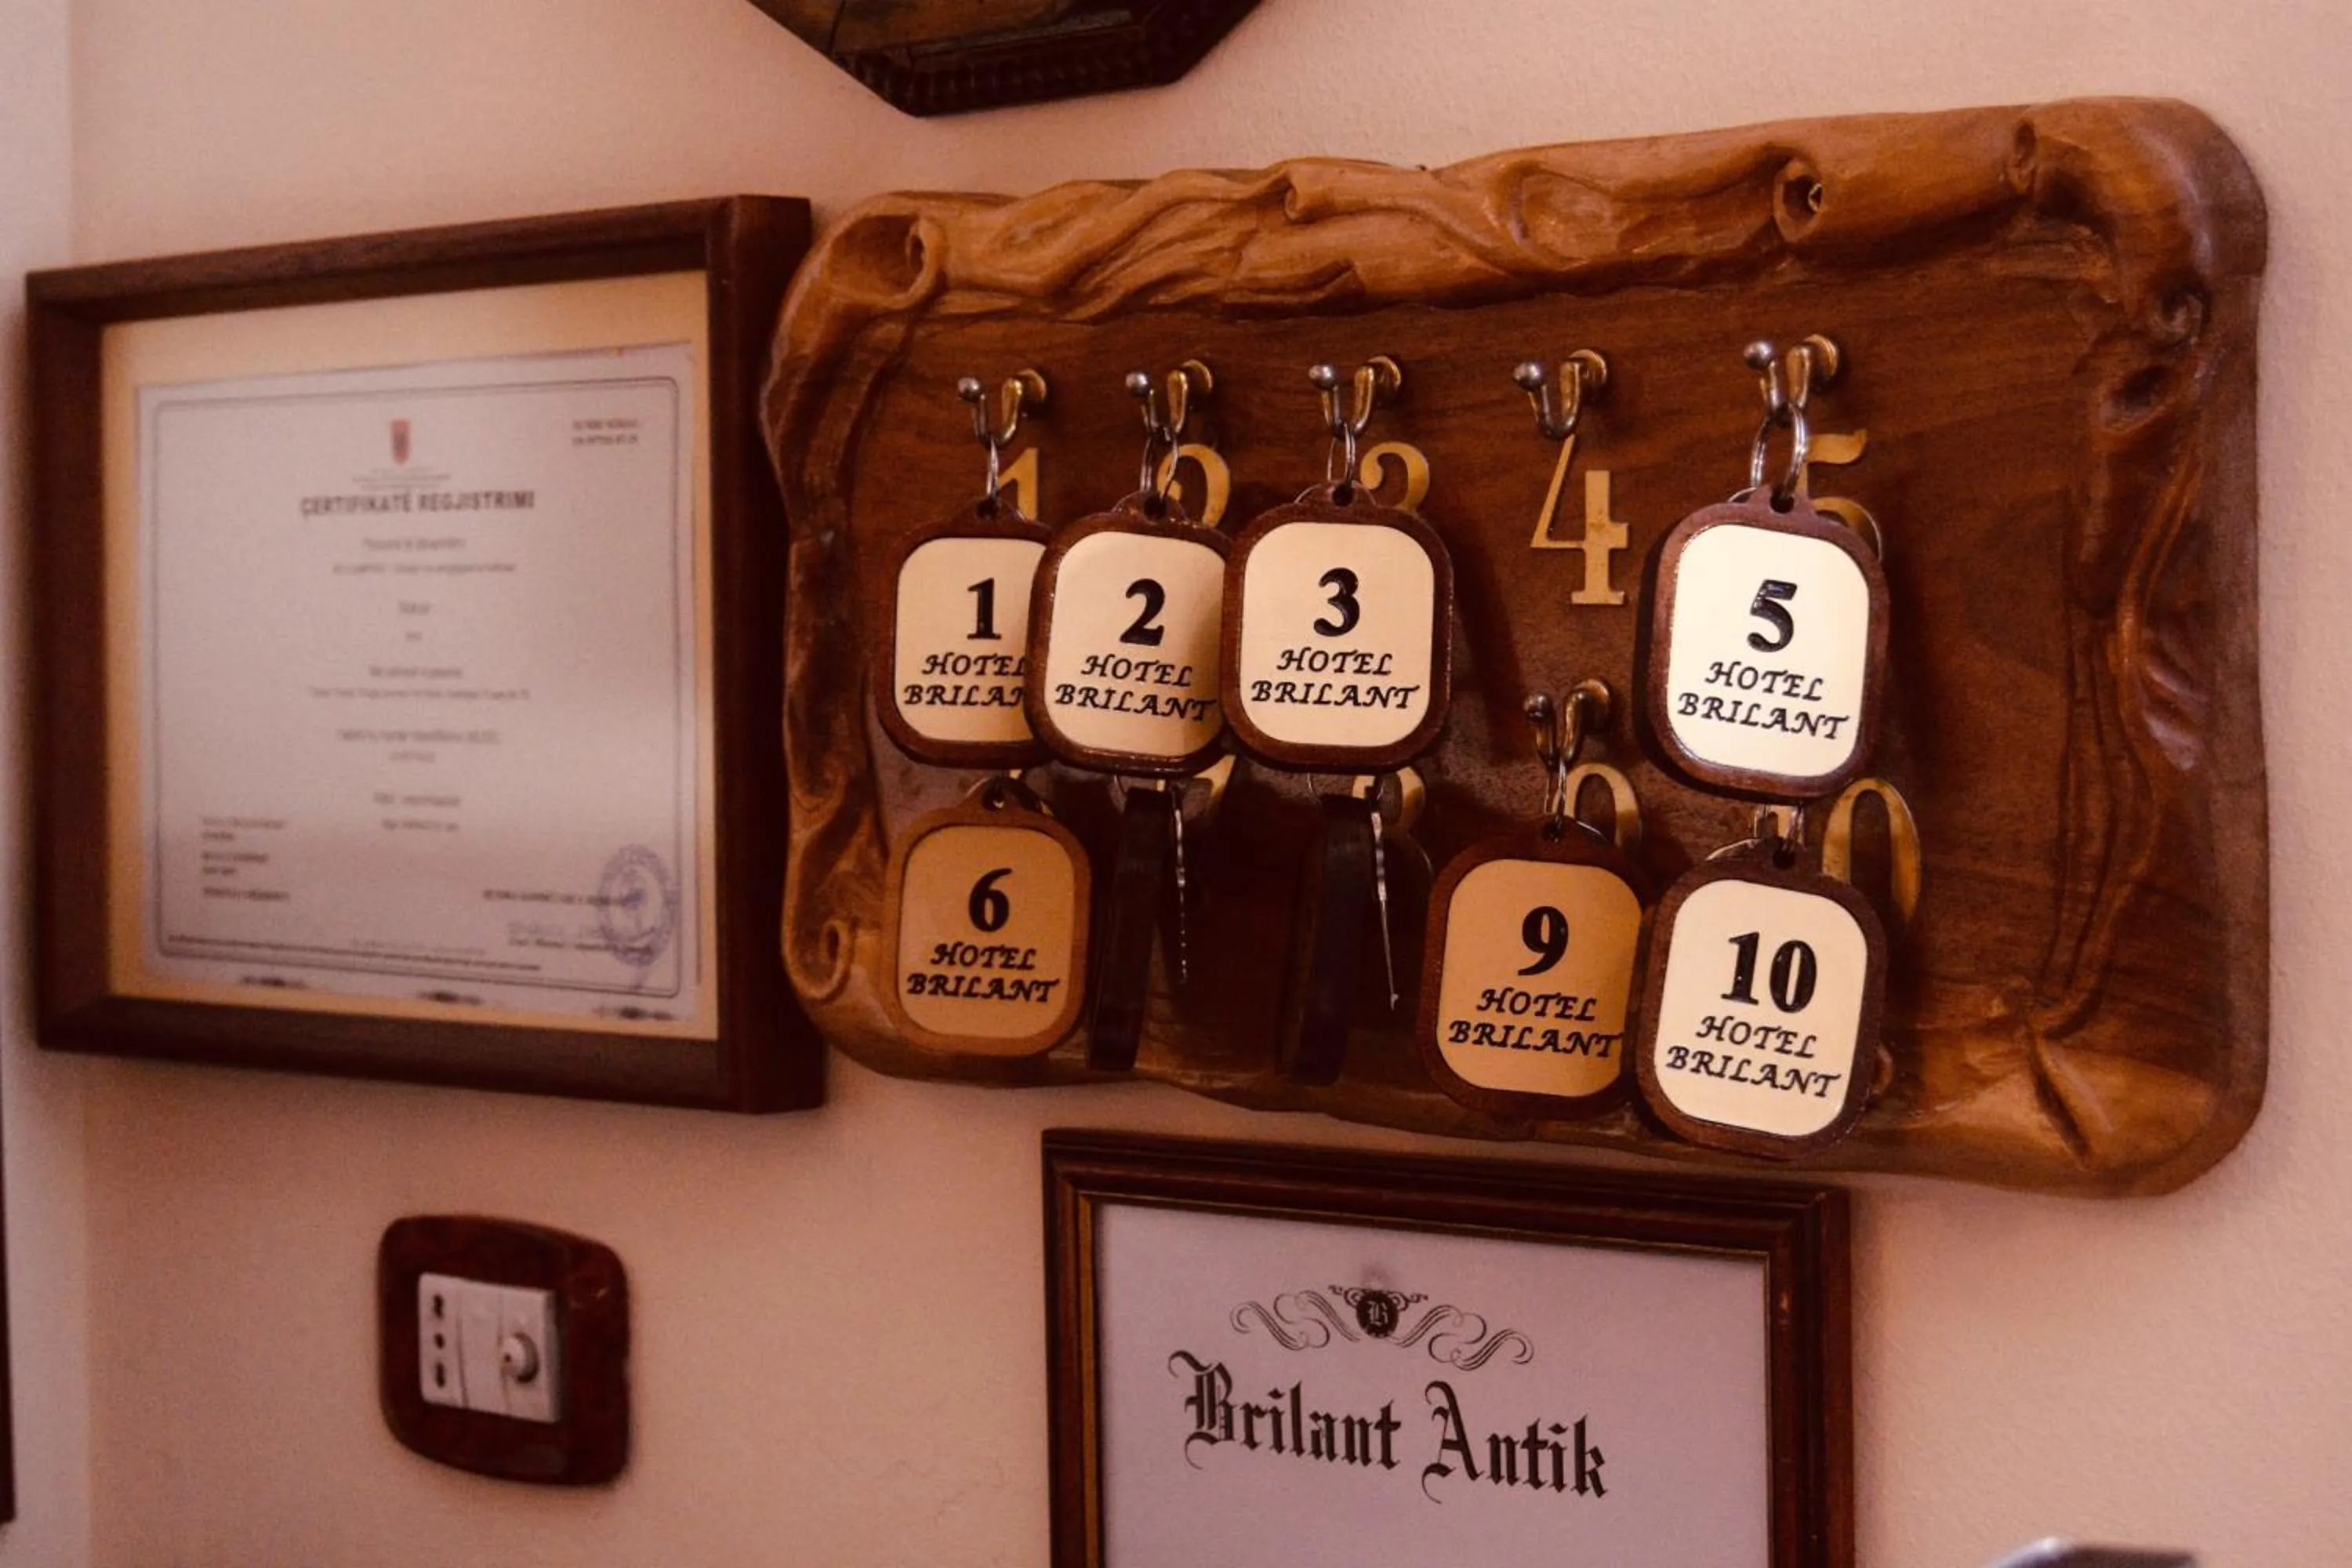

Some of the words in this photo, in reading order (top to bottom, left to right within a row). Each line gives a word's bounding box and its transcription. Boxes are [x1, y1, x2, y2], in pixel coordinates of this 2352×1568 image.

[1530, 433, 1628, 605] 4
[967, 577, 1002, 640] 1
[1120, 578, 1166, 646] 2
[1313, 567, 1360, 637] 3
[1747, 579, 1797, 653] 5
[1080, 653, 1192, 687] HOTEL
[1276, 647, 1392, 676] HOTEL
[1704, 661, 1824, 702] HOTEL
[1054, 683, 1217, 721] BRILANT
[1251, 680, 1419, 709] BRILANT
[1678, 692, 1849, 740] BRILANT
[968, 868, 1013, 932] 6
[930, 942, 1037, 971] HOTEL
[1517, 906, 1569, 976] 9
[907, 973, 1059, 1003] BRILANT
[1720, 931, 1817, 1014] 10
[1476, 987, 1597, 1022] HOTEL
[1448, 1020, 1623, 1058] BRILANT
[1695, 1015, 1817, 1059] HOTEL
[1666, 1046, 1841, 1098] BRILANT
[1167, 1349, 1401, 1470] Brilant
[1421, 1380, 1608, 1504] Antik
